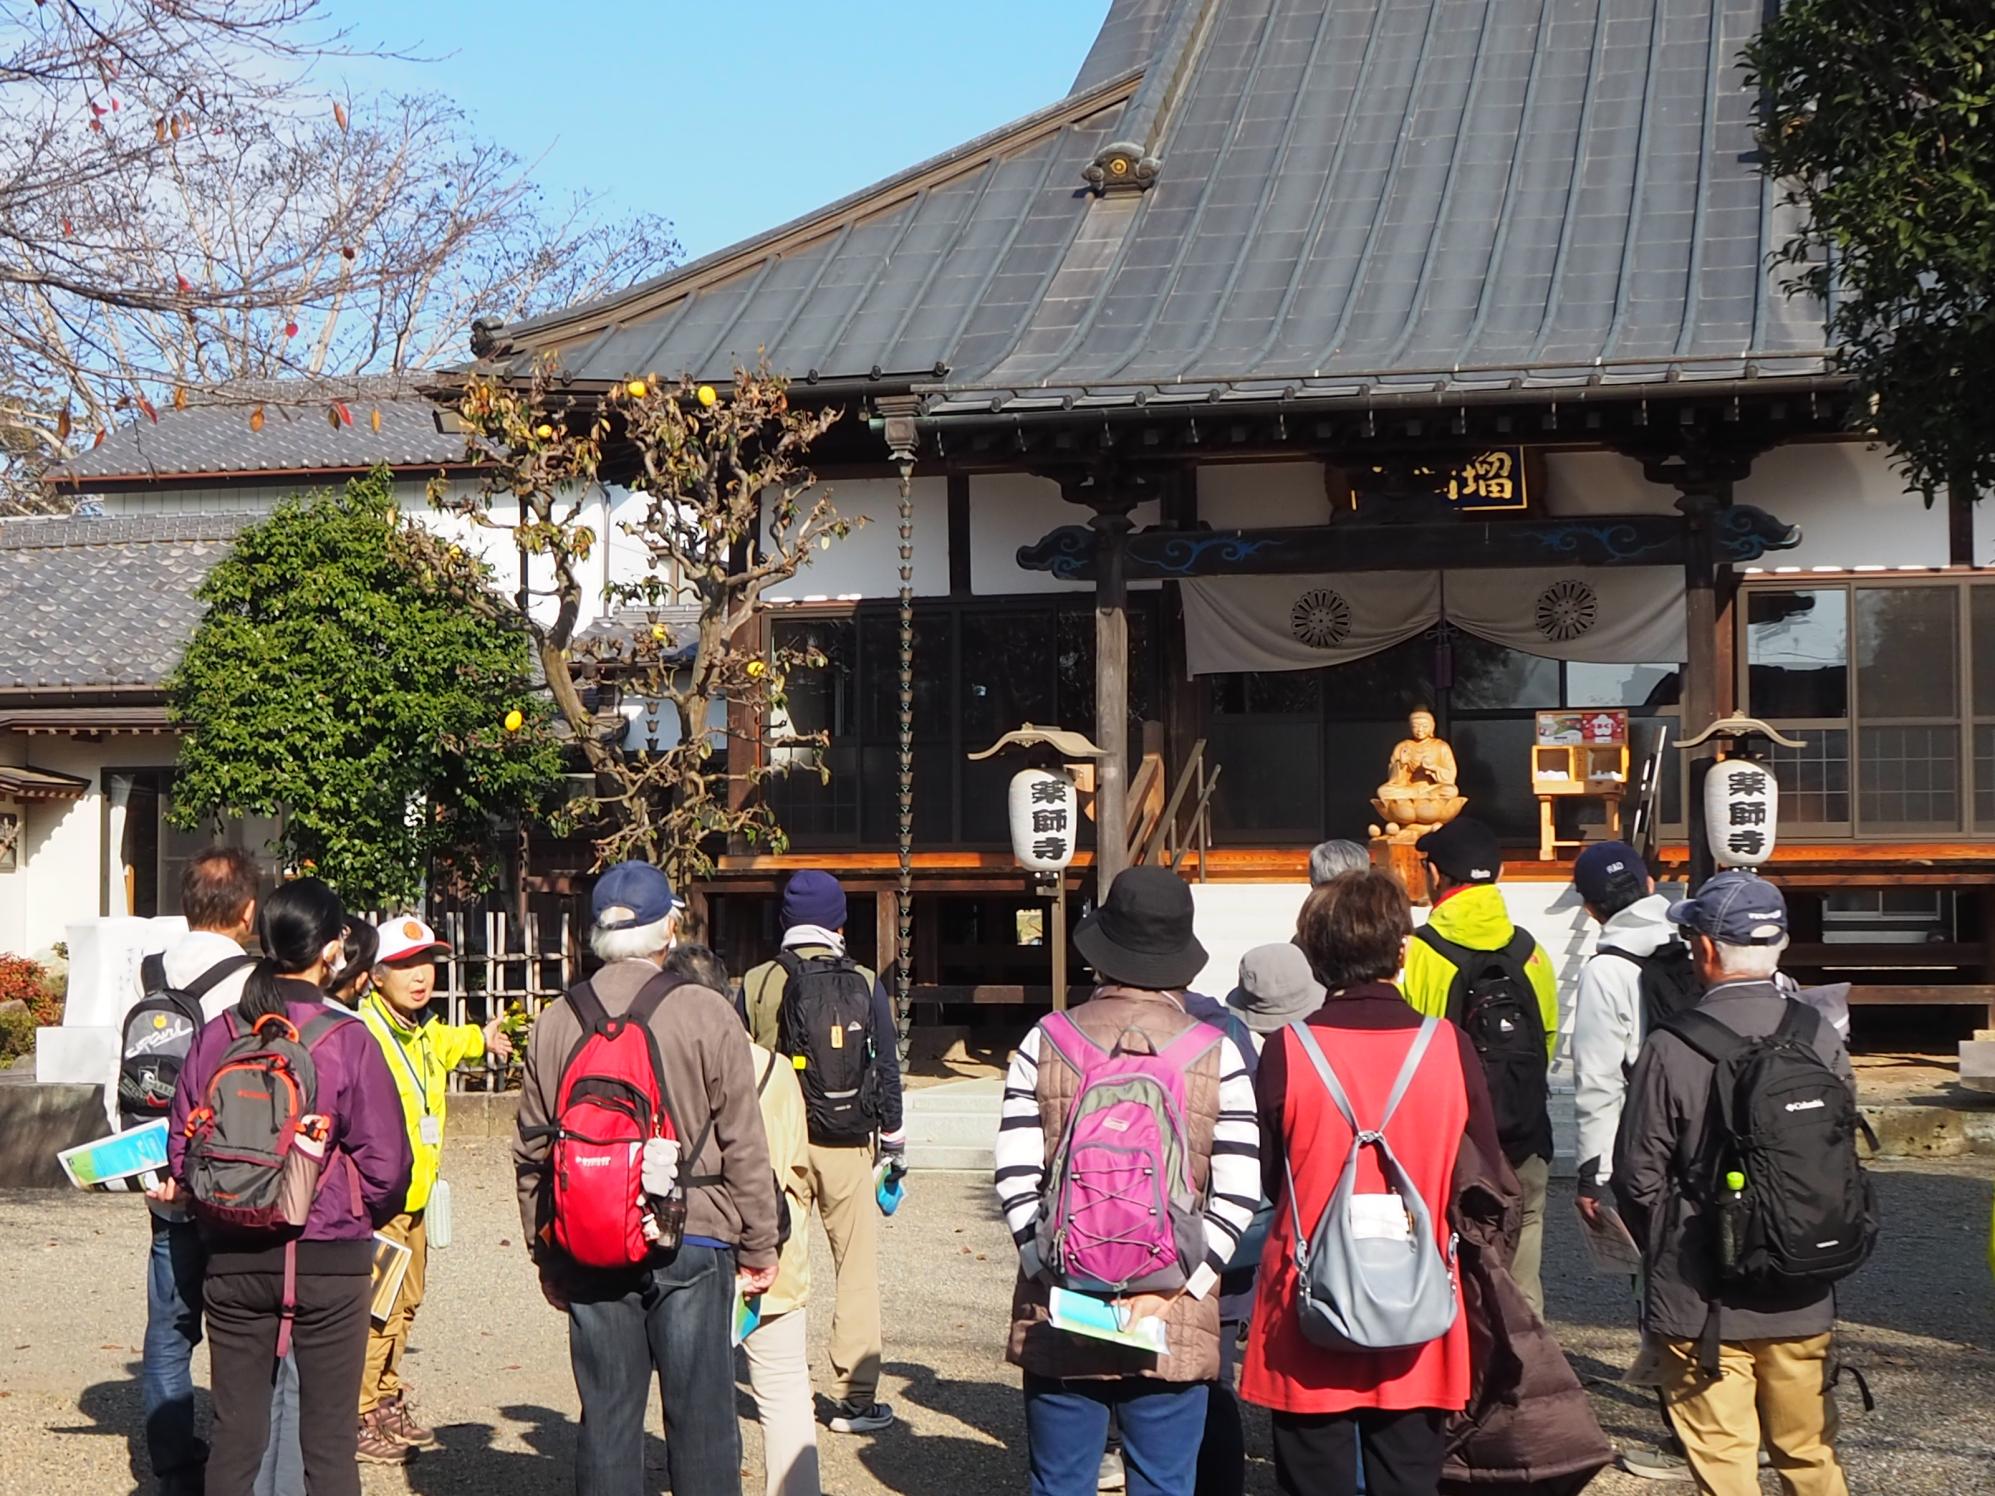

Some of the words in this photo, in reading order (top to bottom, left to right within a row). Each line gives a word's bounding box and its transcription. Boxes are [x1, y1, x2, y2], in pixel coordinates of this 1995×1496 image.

[1031, 780, 1067, 860] 薬師寺
[1728, 771, 1766, 855] 薬師寺
